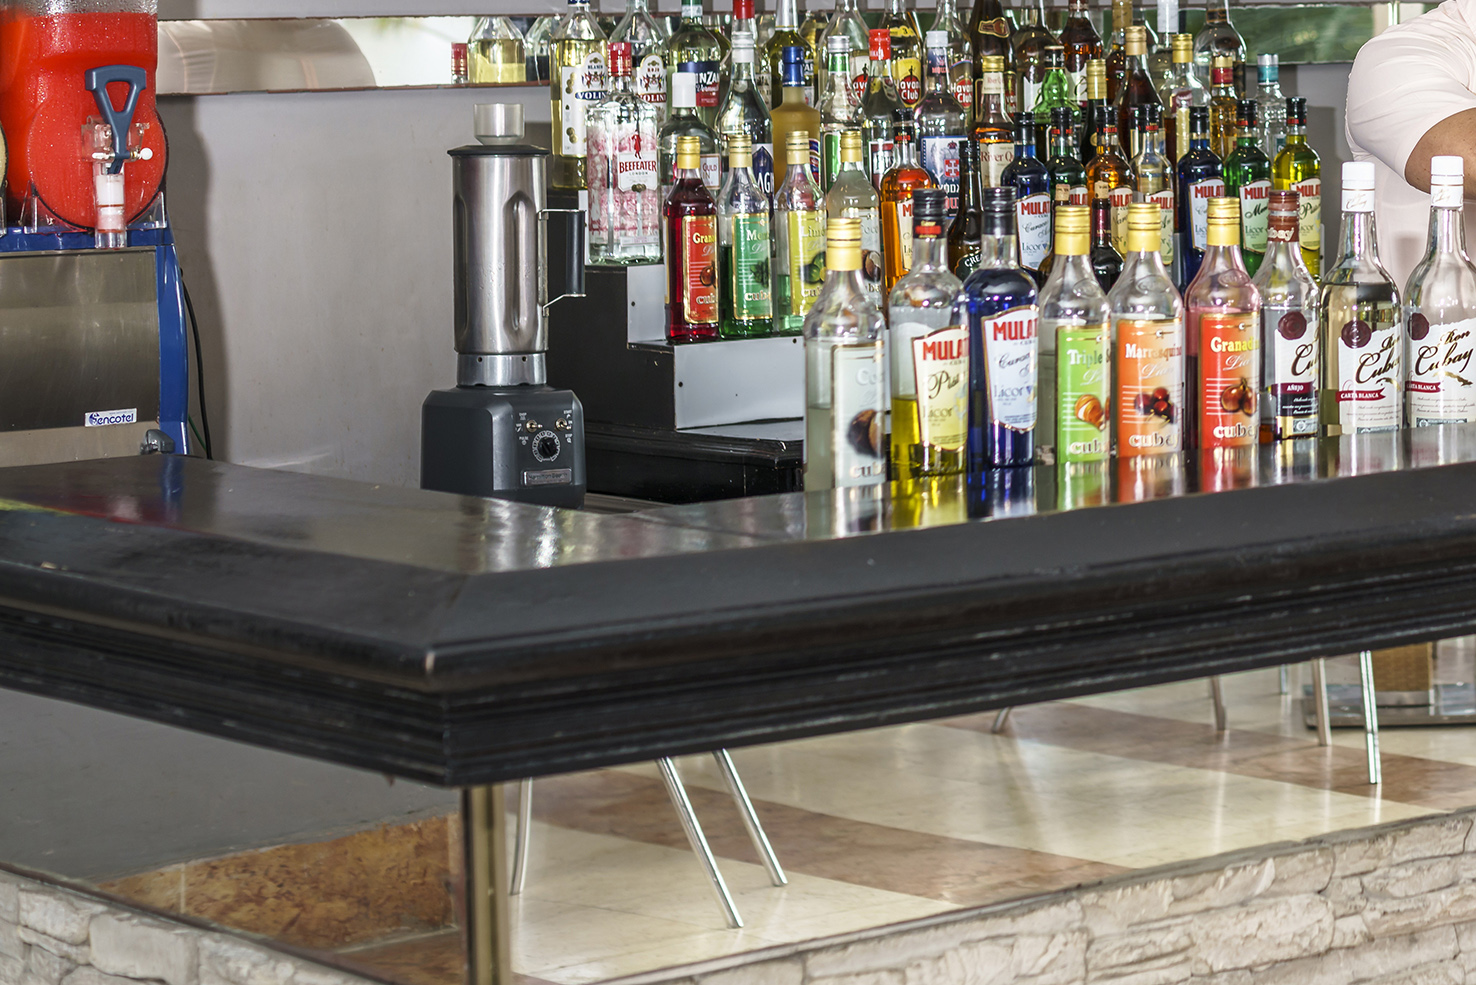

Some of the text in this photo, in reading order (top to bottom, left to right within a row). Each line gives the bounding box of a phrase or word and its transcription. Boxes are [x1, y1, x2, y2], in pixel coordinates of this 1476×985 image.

[901, 89, 919, 100] Club
[619, 160, 657, 174] BEEFEATER
[1437, 329, 1471, 350] Ron
[1066, 349, 1103, 368] Triple
[1414, 342, 1474, 376] Cubay
[1286, 383, 1305, 393] AÑEJO
[1358, 392, 1380, 400] BLANCA
